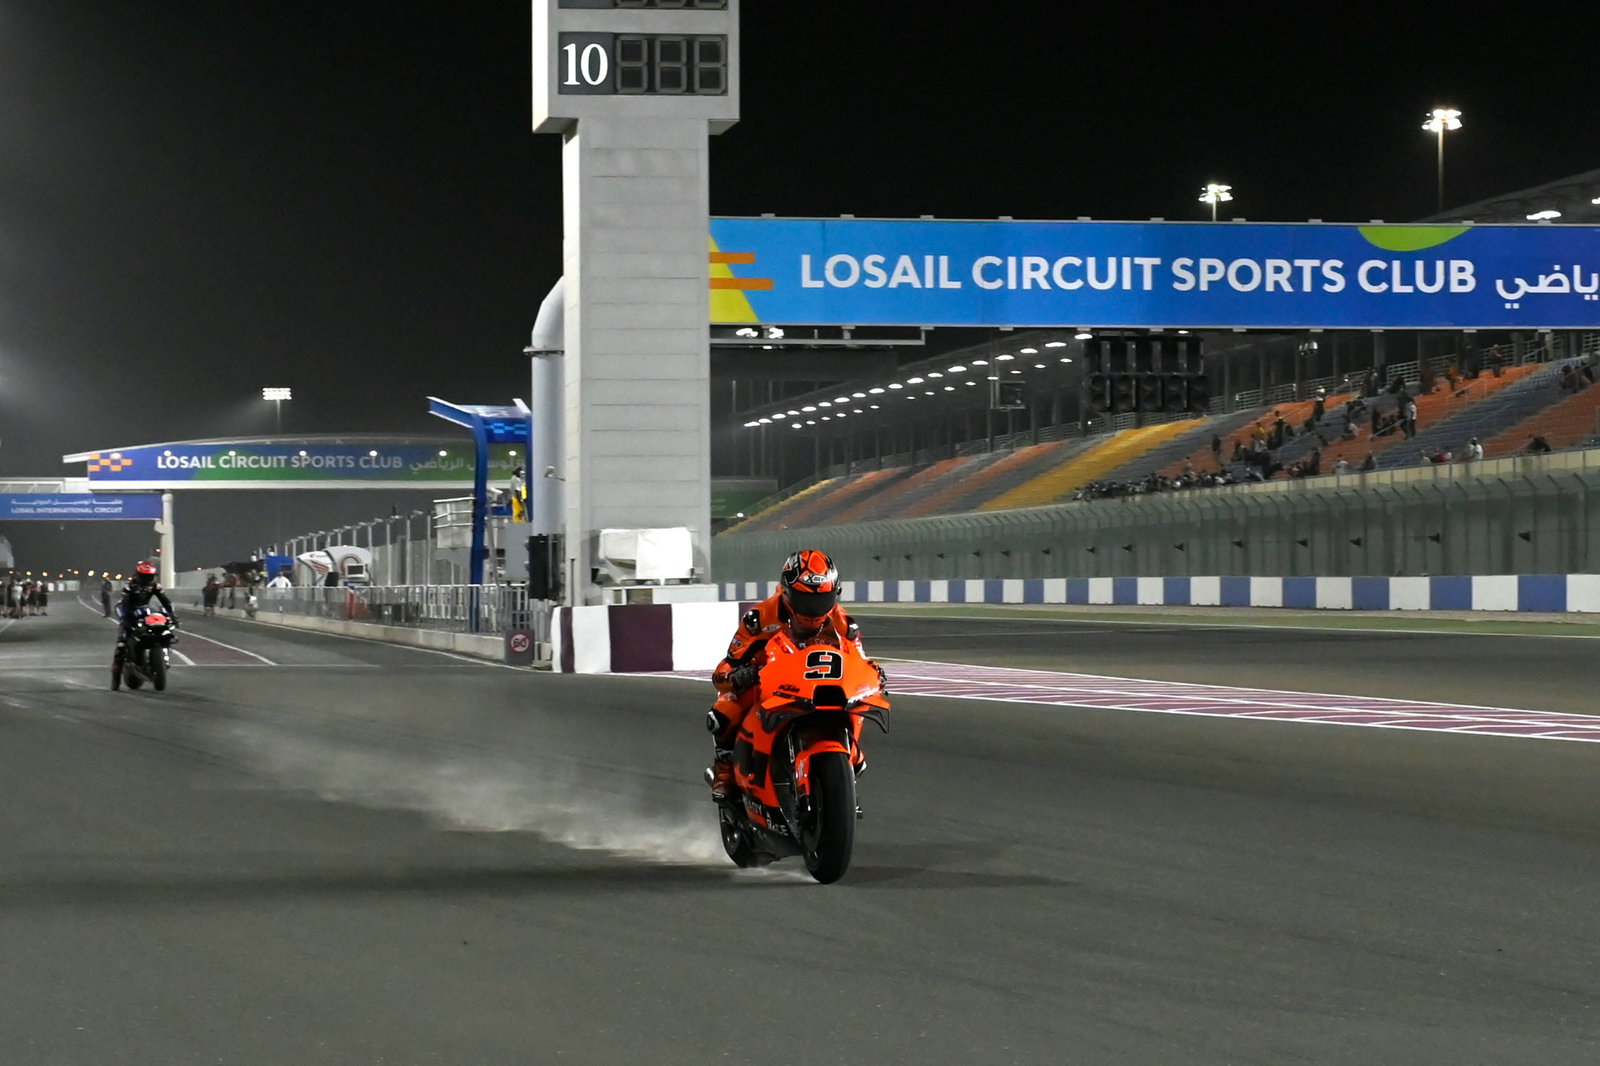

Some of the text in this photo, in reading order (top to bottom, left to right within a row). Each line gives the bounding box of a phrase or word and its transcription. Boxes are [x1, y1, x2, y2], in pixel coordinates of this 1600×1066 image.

[563, 43, 608, 86] 10
[801, 253, 1477, 294] LOSAIL CIRCUIT SPORTS CLUB
[1495, 264, 1600, 309] ياضي
[157, 455, 403, 469] LOSAIL CIRCUIT SPORTS CLUB
[803, 650, 843, 680] 9
